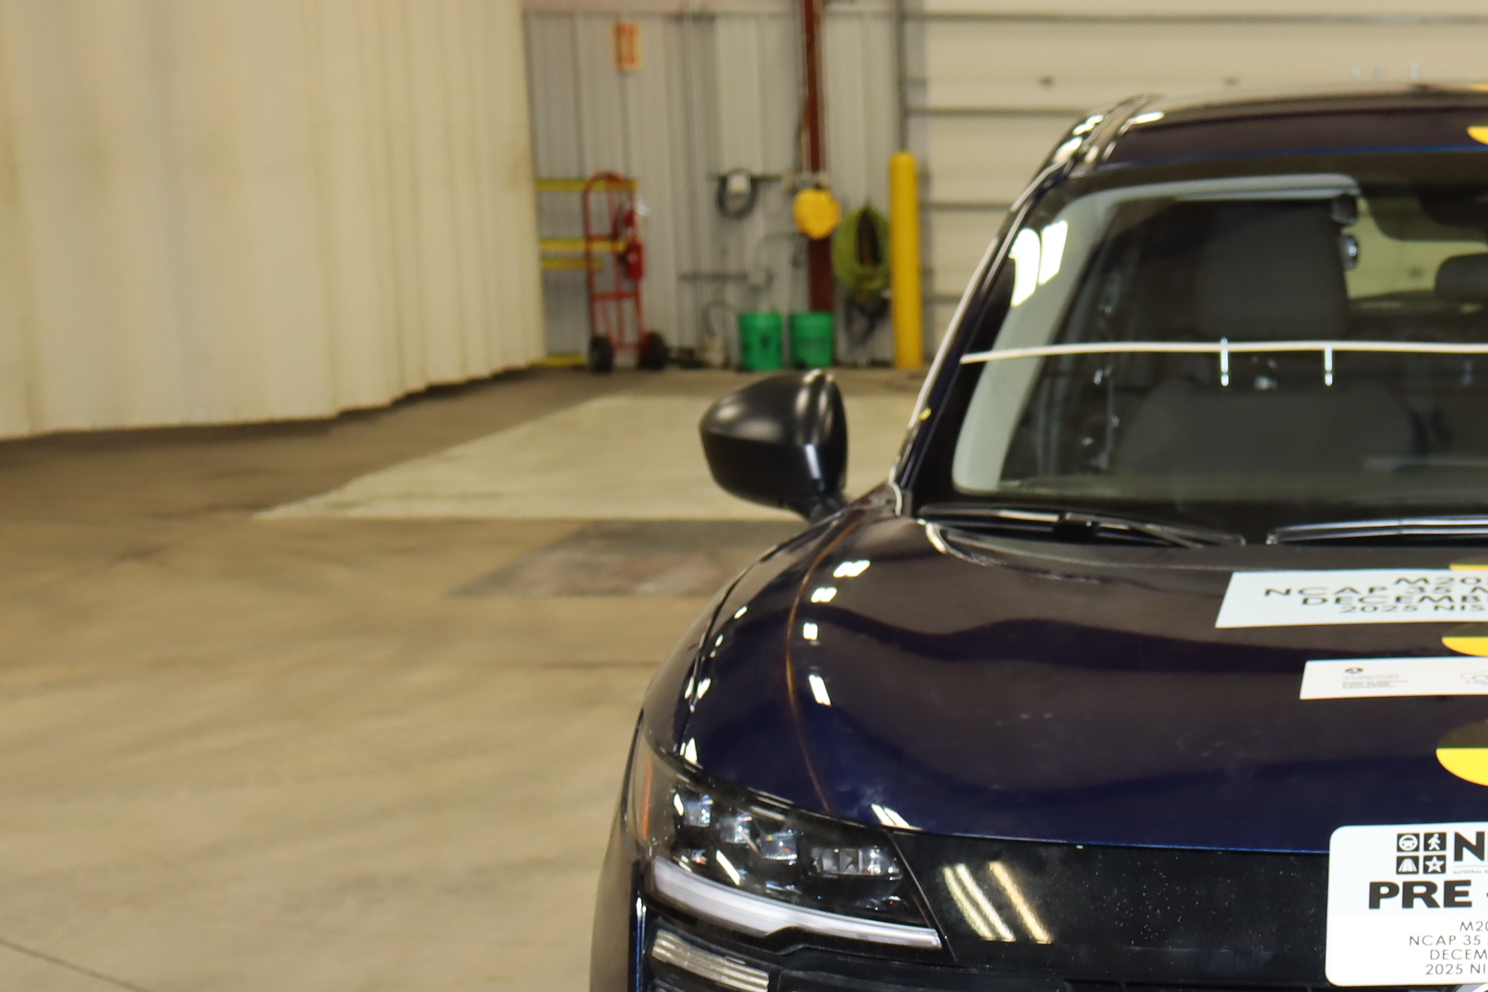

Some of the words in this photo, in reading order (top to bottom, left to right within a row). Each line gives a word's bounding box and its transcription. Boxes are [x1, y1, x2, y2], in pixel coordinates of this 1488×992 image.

[1263, 585, 1389, 597] NCAP
[1404, 585, 1452, 595] 35
[1339, 604, 1419, 614] 2025
[1368, 879, 1473, 910] PRE
[1409, 934, 1457, 947] NCAP
[1463, 934, 1481, 947] 35
[1425, 963, 1464, 976] 2025
